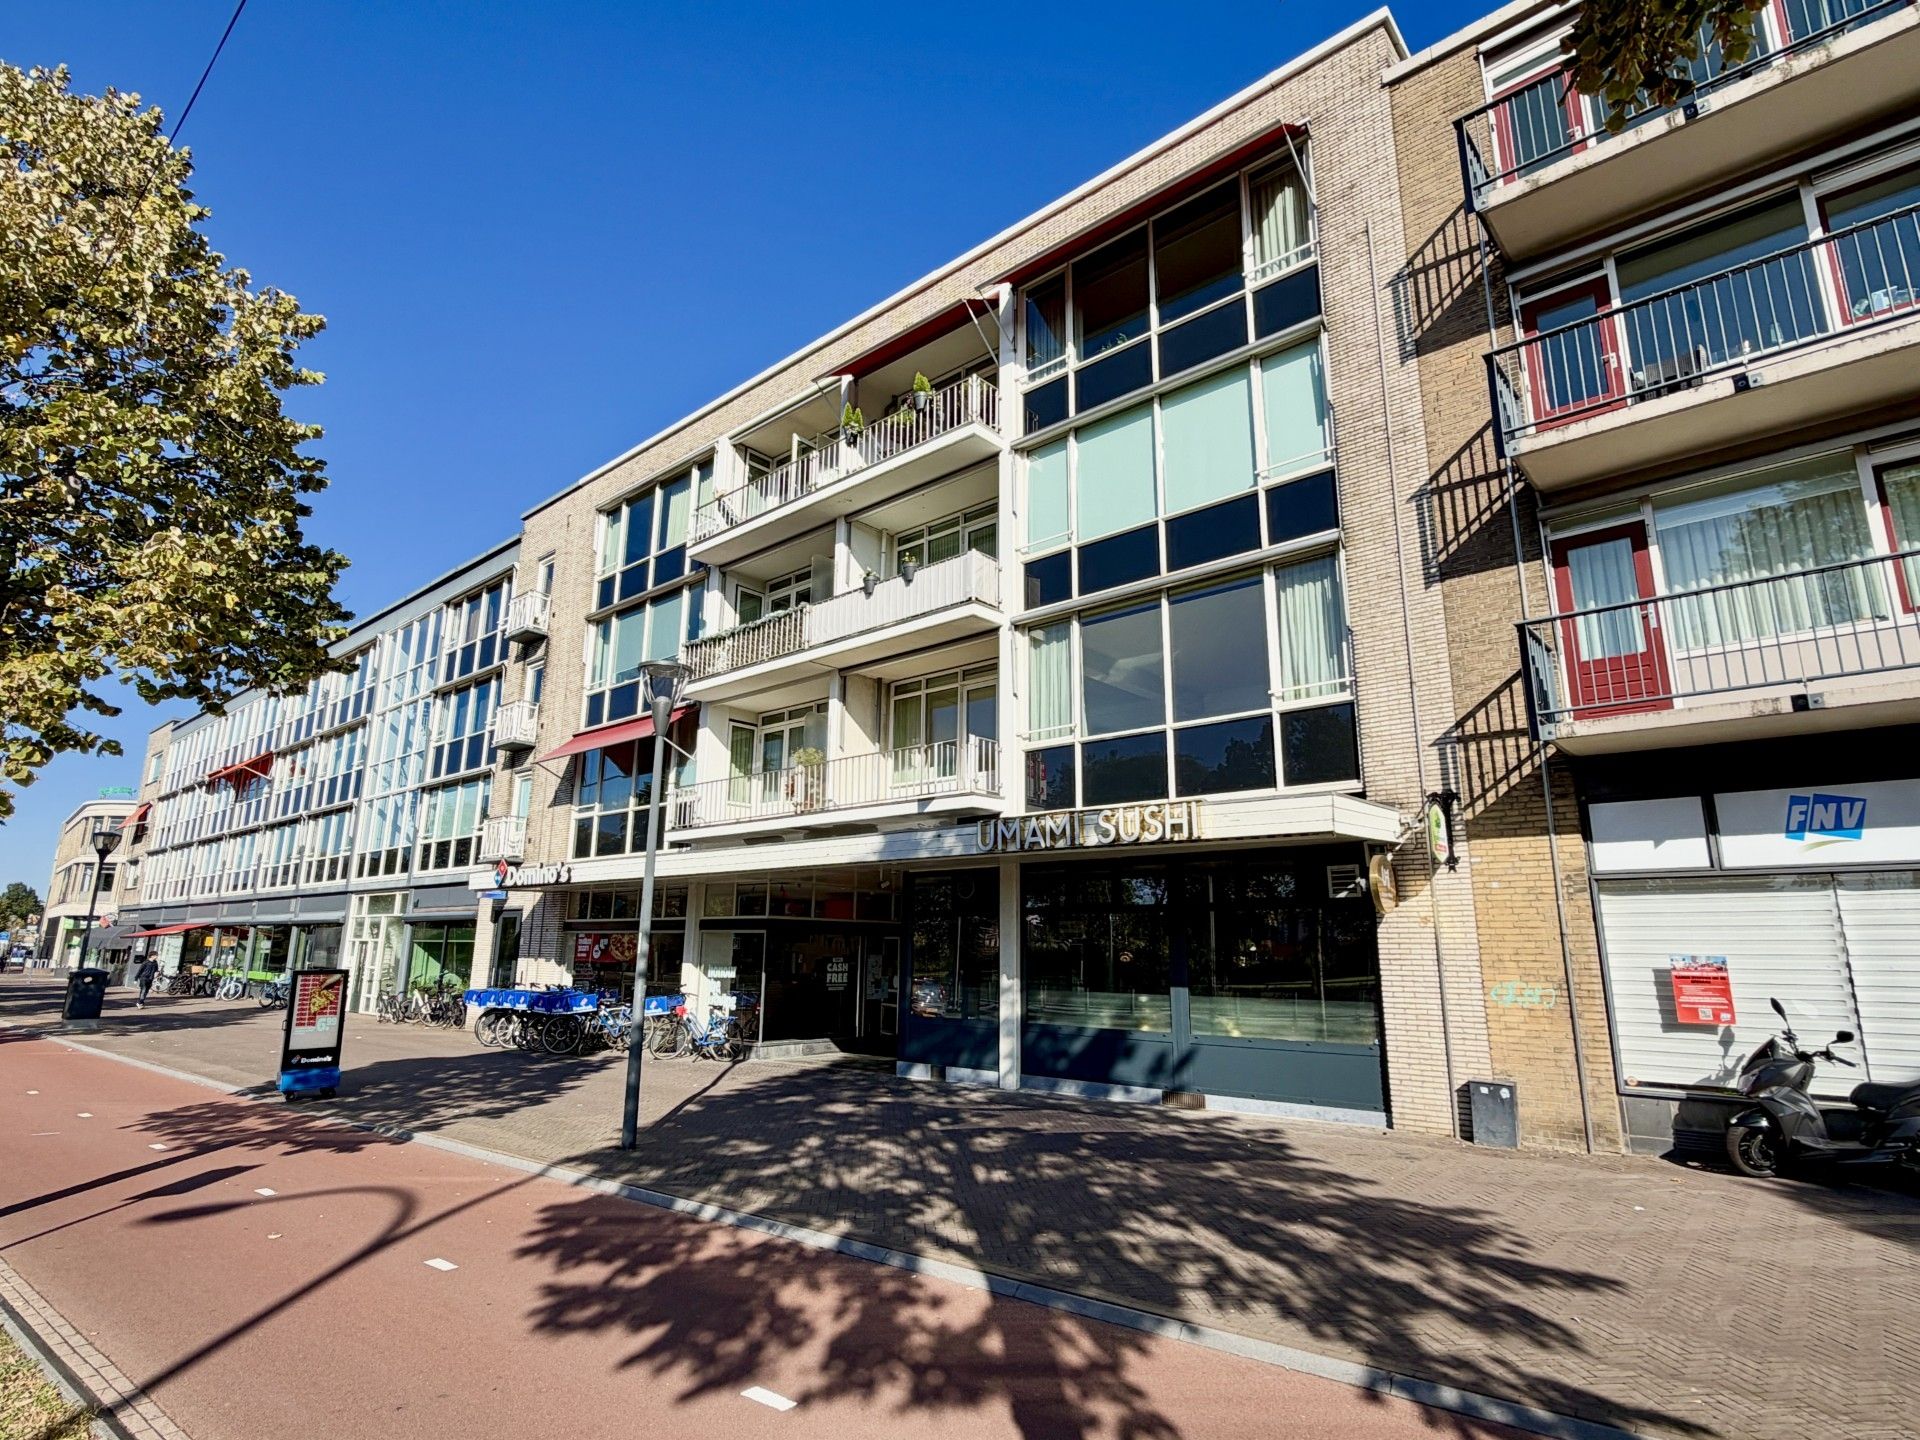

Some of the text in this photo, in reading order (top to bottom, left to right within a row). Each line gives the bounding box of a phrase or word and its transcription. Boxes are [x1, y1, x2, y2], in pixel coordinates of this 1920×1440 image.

[977, 802, 1198, 851] UMAMI SUSHI
[1788, 801, 1865, 831] FNV
[503, 862, 571, 887] Domino's
[826, 962, 849, 972] CASH
[826, 972, 848, 983] FREE
